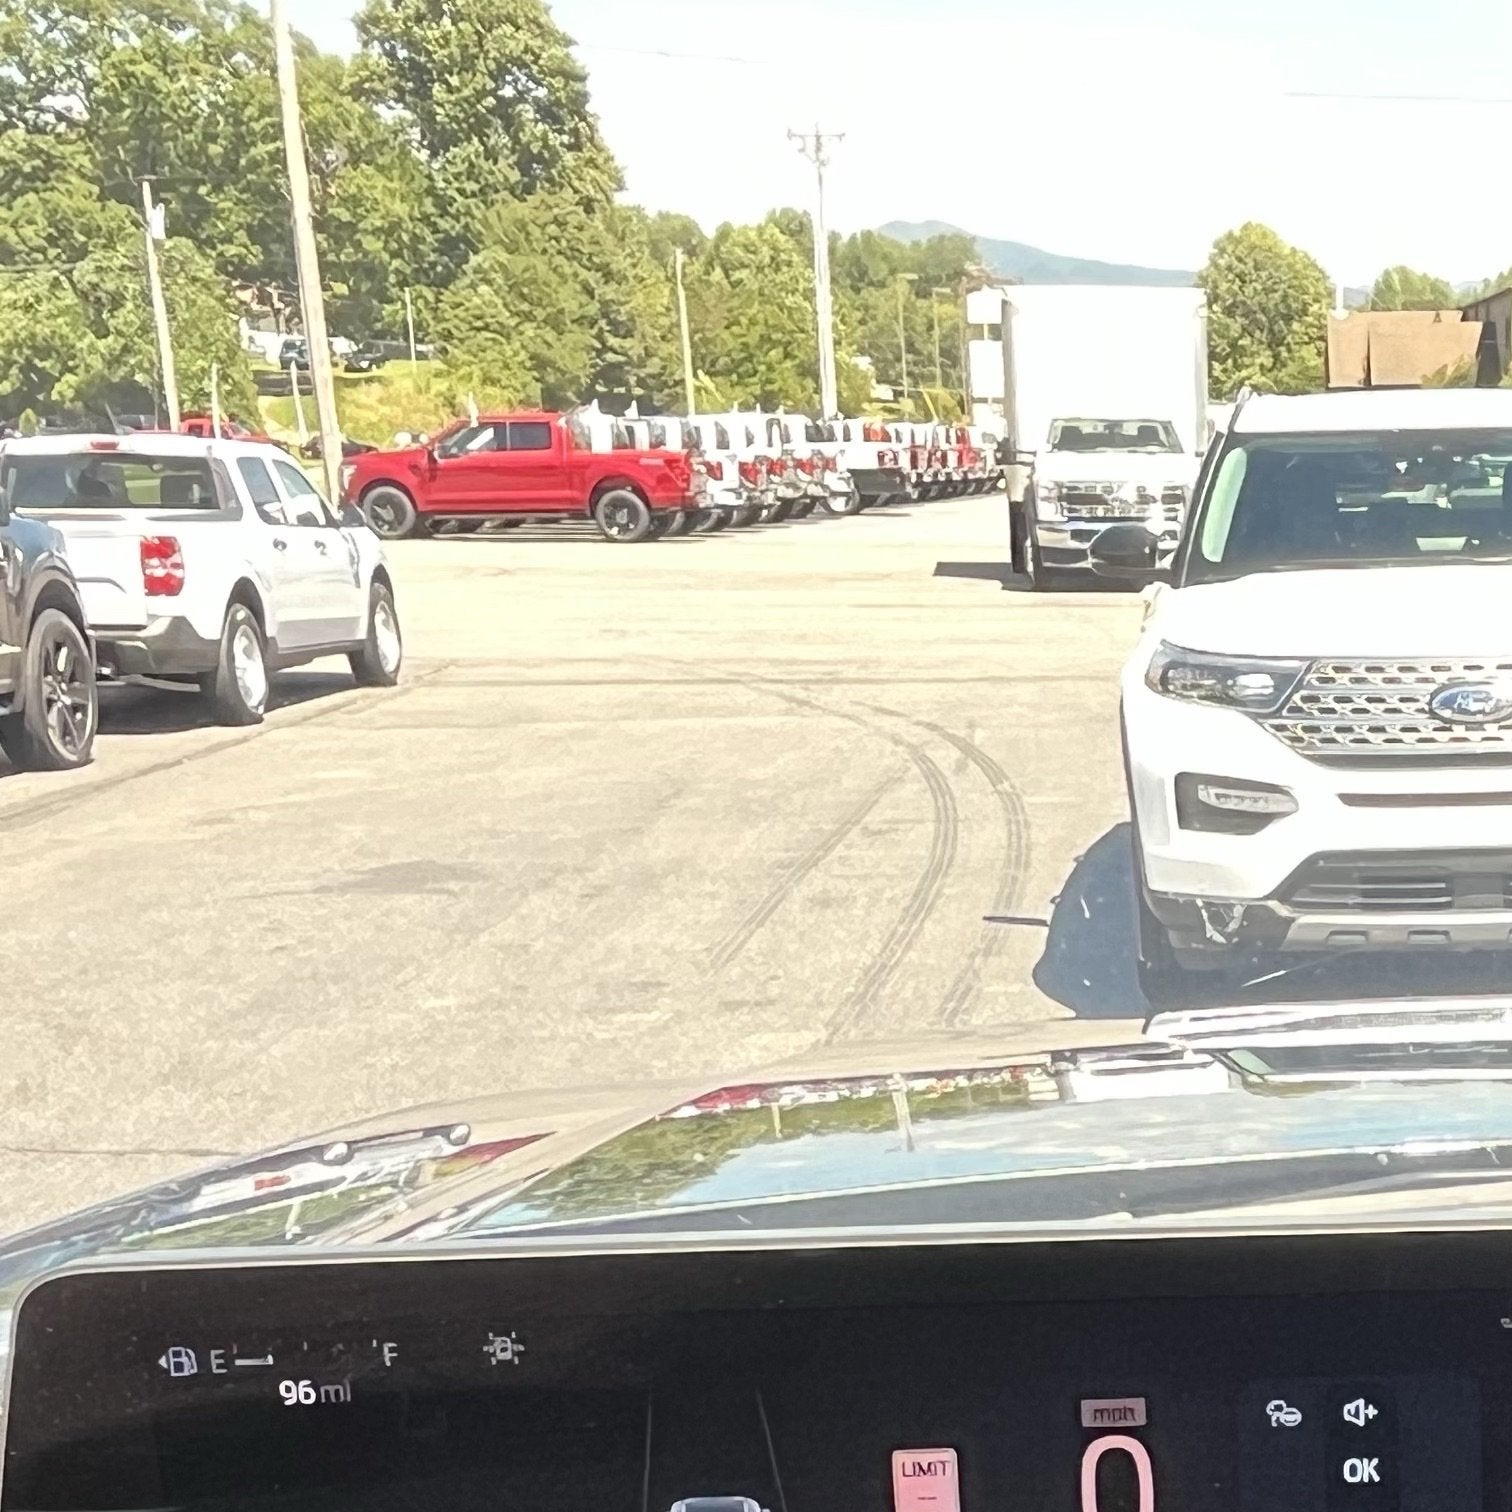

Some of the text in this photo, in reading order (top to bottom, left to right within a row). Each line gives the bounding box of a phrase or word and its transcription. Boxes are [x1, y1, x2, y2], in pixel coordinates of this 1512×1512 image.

[210, 1349, 228, 1374] E
[382, 1342, 399, 1367] F
[278, 1379, 317, 1406] 96
[902, 1461, 951, 1477] LIMIT
[1342, 1457, 1381, 1483] OK
